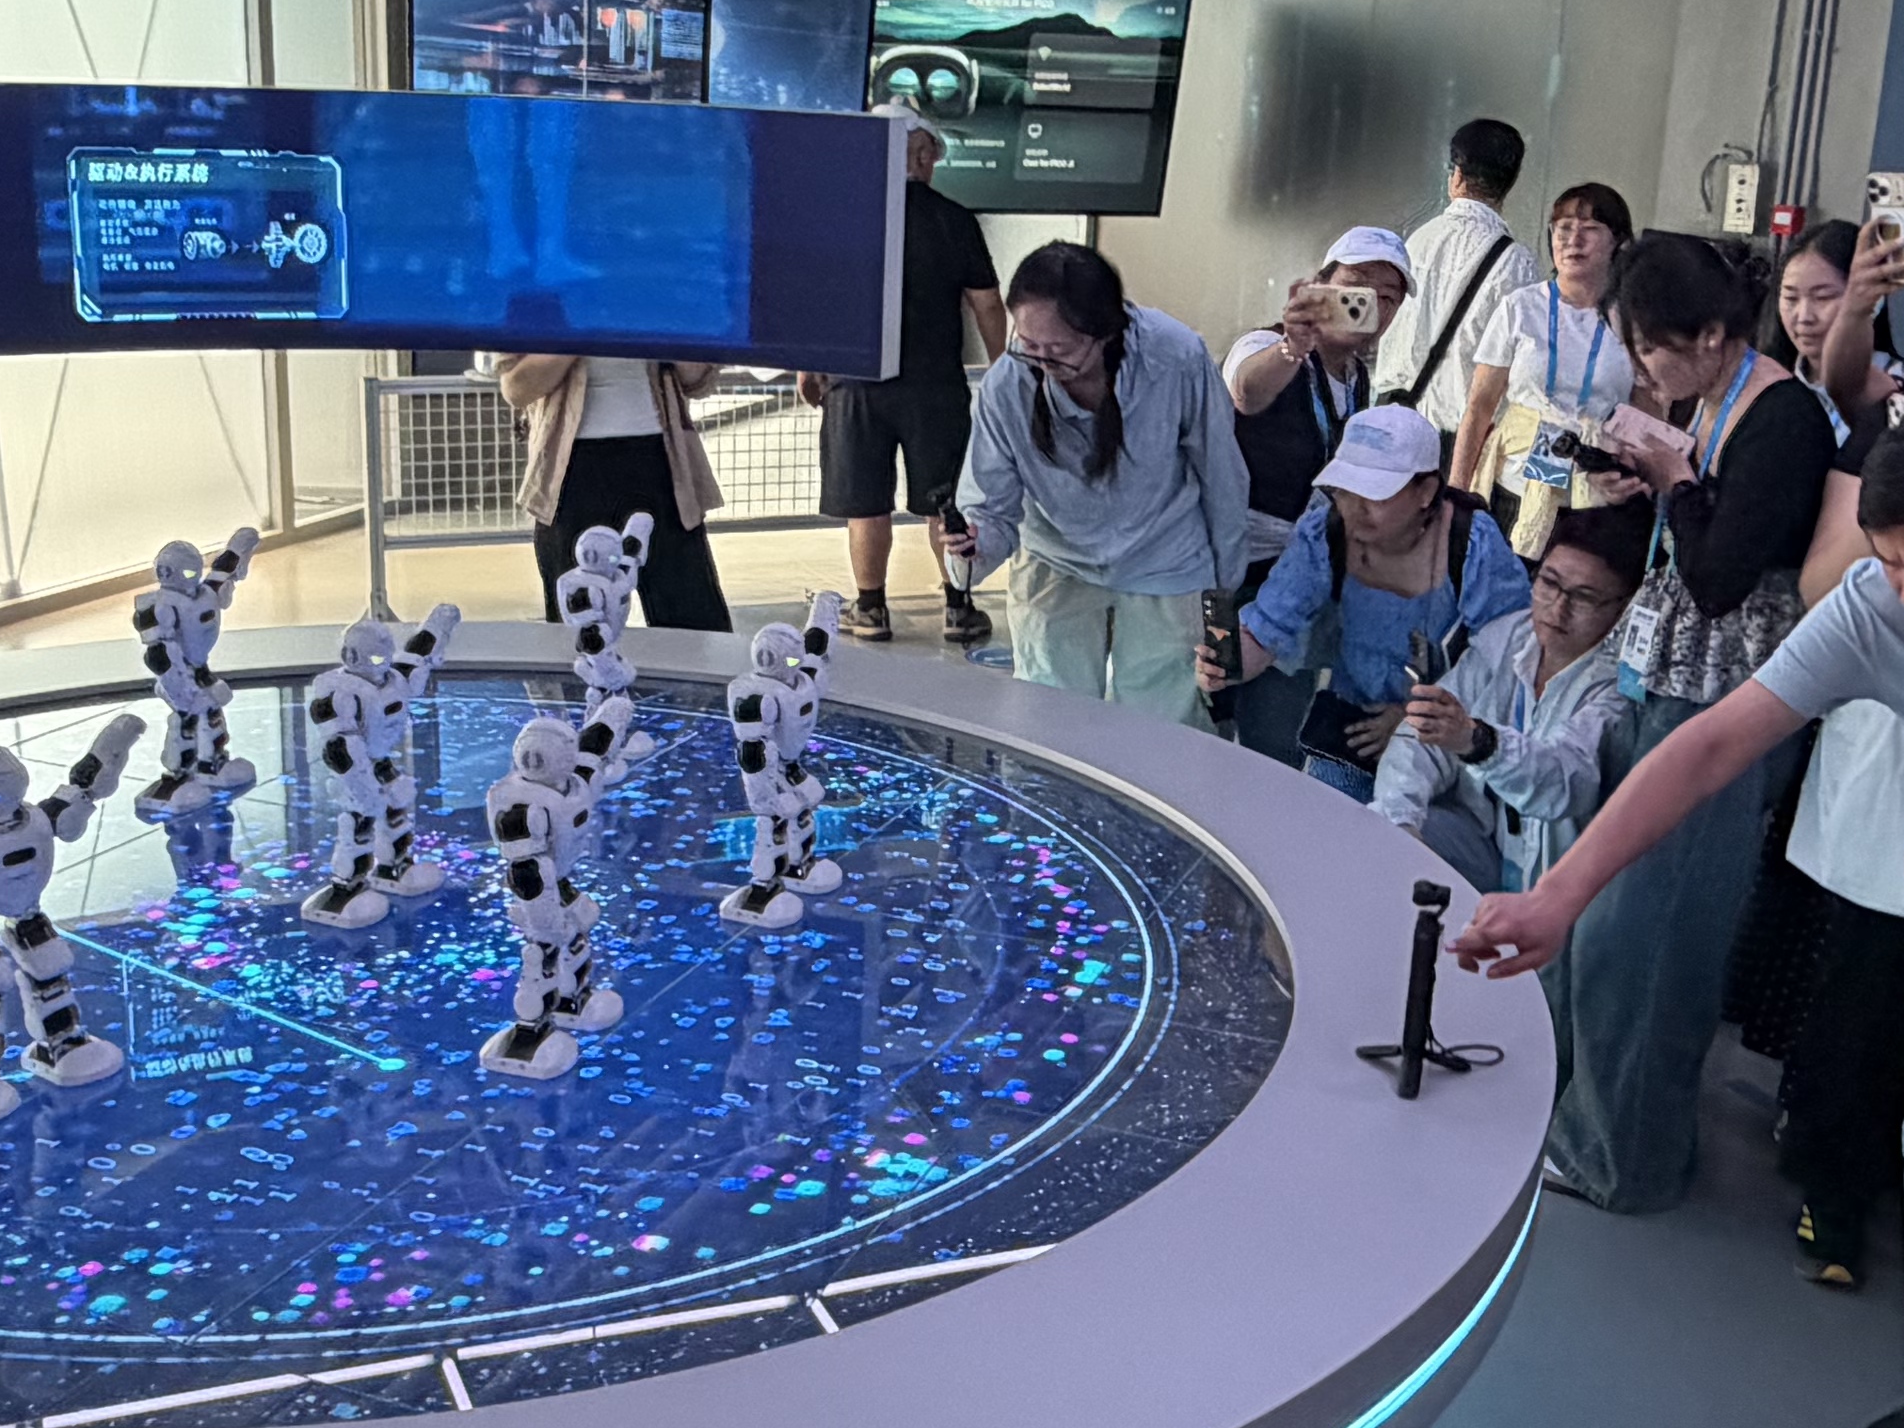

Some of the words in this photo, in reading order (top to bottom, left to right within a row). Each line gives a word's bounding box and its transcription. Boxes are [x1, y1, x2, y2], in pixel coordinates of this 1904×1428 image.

[88, 162, 209, 184] 驱动&执行系统
